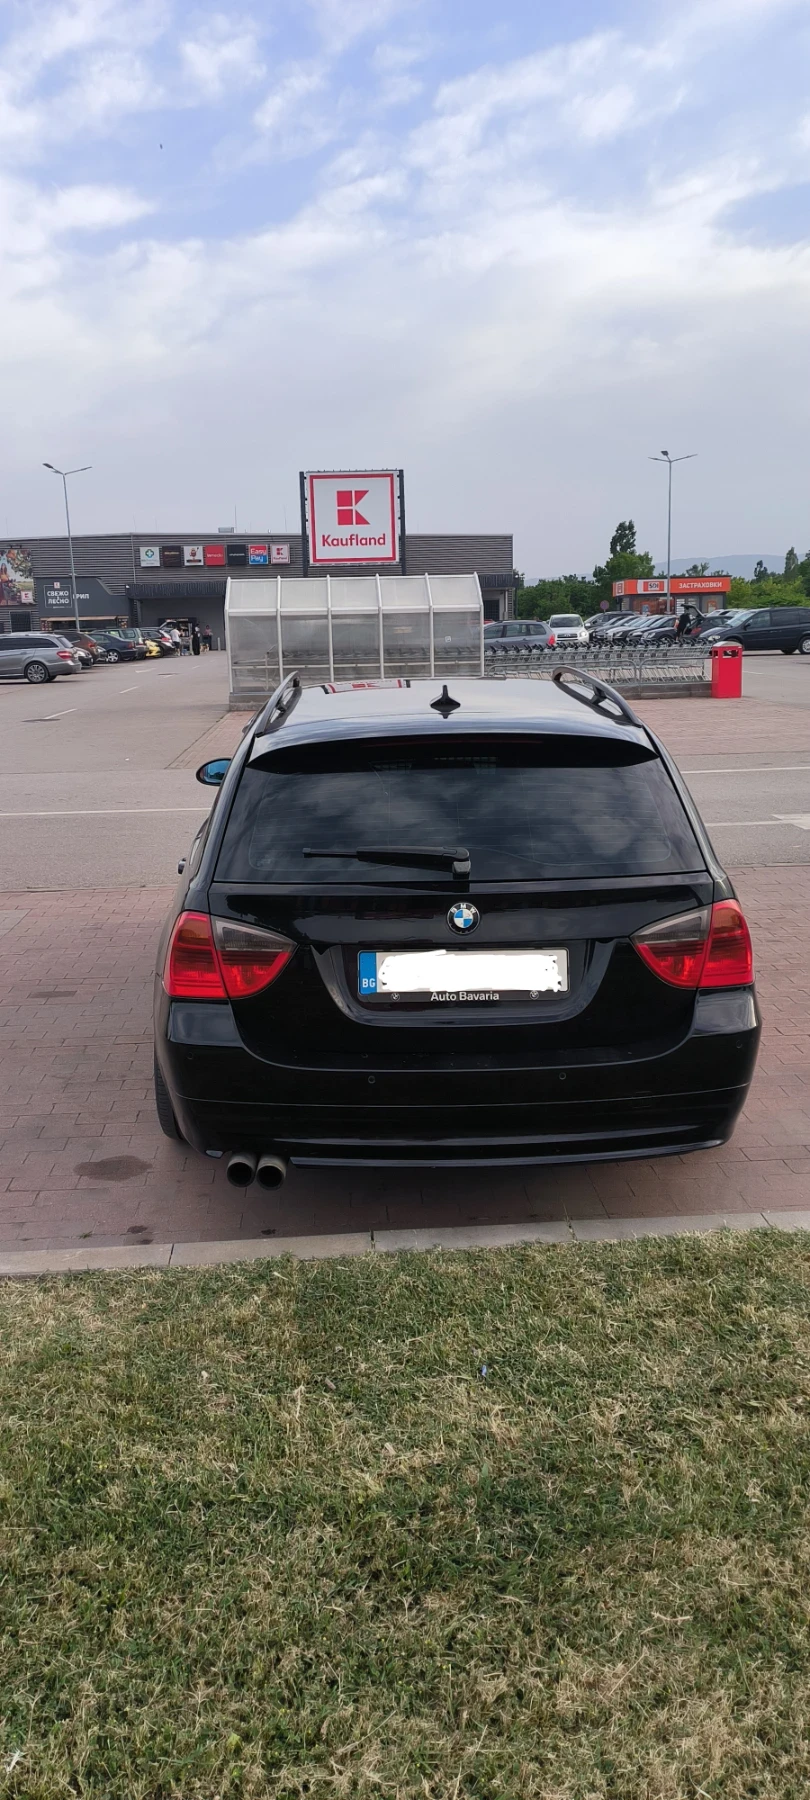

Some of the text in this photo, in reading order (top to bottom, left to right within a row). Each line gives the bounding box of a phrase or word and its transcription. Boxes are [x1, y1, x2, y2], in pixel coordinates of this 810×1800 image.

[321, 533, 386, 547] Kaufland
[250, 548, 266, 556] Easy
[250, 555, 264, 563] Pay
[450, 902, 477, 914] BMW
[362, 978, 376, 988] BG
[430, 991, 500, 1001] Auto Bavaria
